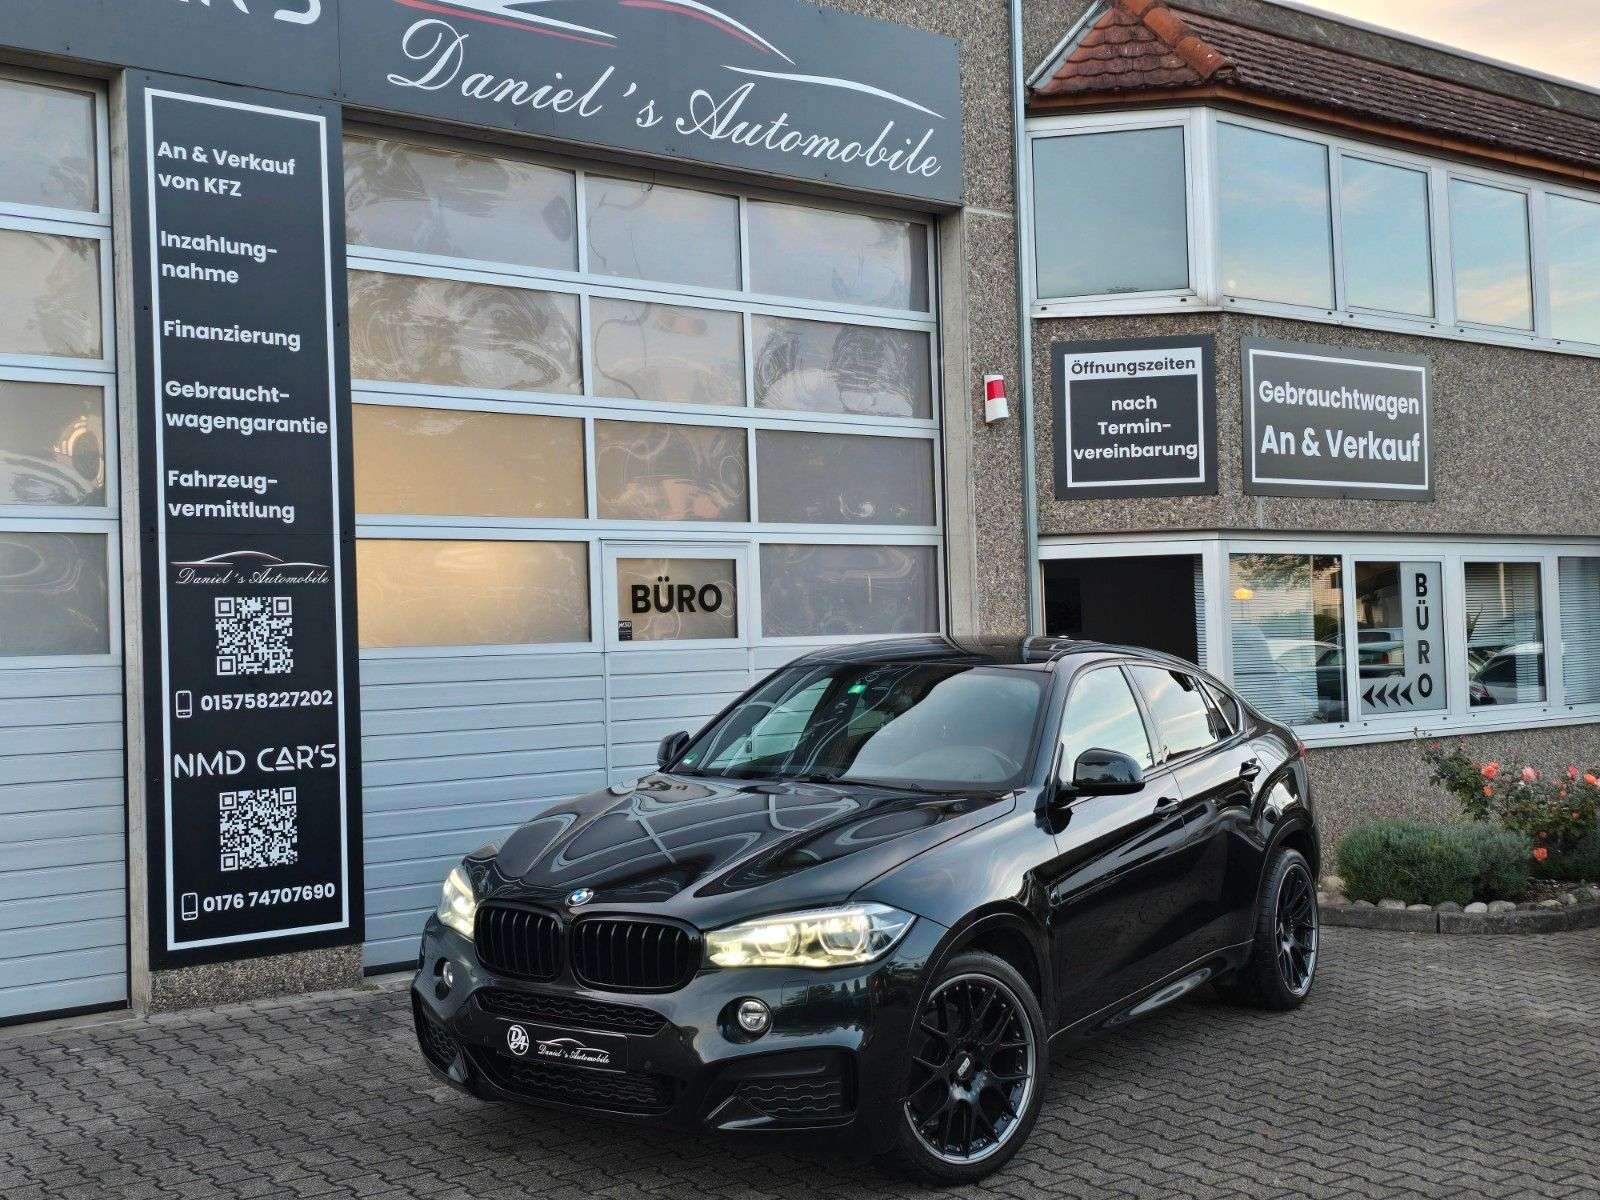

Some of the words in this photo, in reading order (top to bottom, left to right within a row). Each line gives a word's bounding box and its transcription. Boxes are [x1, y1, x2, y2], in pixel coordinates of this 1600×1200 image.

[675, 82, 942, 177] Automobile
[158, 141, 187, 159] An
[192, 146, 208, 163] &
[213, 149, 296, 175] Verkauf
[158, 173, 199, 191] von
[204, 177, 242, 197] KFZ
[160, 231, 277, 263] Inzahlung-
[162, 263, 239, 283] nahme
[163, 320, 301, 352] Finanzierung
[1071, 358, 1195, 375] Öffnungszeiten
[165, 381, 290, 402] Gebraucht-
[1111, 395, 1157, 411] nach
[1258, 380, 1419, 420] Gebrauchtwagen
[166, 413, 328, 435] wagengarantie
[1098, 418, 1171, 435] Termin-
[1073, 443, 1198, 460] vereinbarung
[1261, 425, 1296, 455] An
[1302, 427, 1321, 457] &
[1326, 429, 1420, 462] Verkauf
[168, 470, 278, 494] Fahrzeug-
[168, 500, 295, 523] vermittlung
[249, 568, 330, 585] Automobile
[631, 576, 722, 613] BÜRO
[1415, 572, 1433, 698] BÜRO
[200, 690, 333, 711] 015758227202
[173, 750, 246, 778] NMD
[257, 744, 337, 772] CAR'S
[203, 893, 244, 912] 0176
[249, 883, 335, 907] 74707690
[569, 1049, 611, 1064] Automobile
